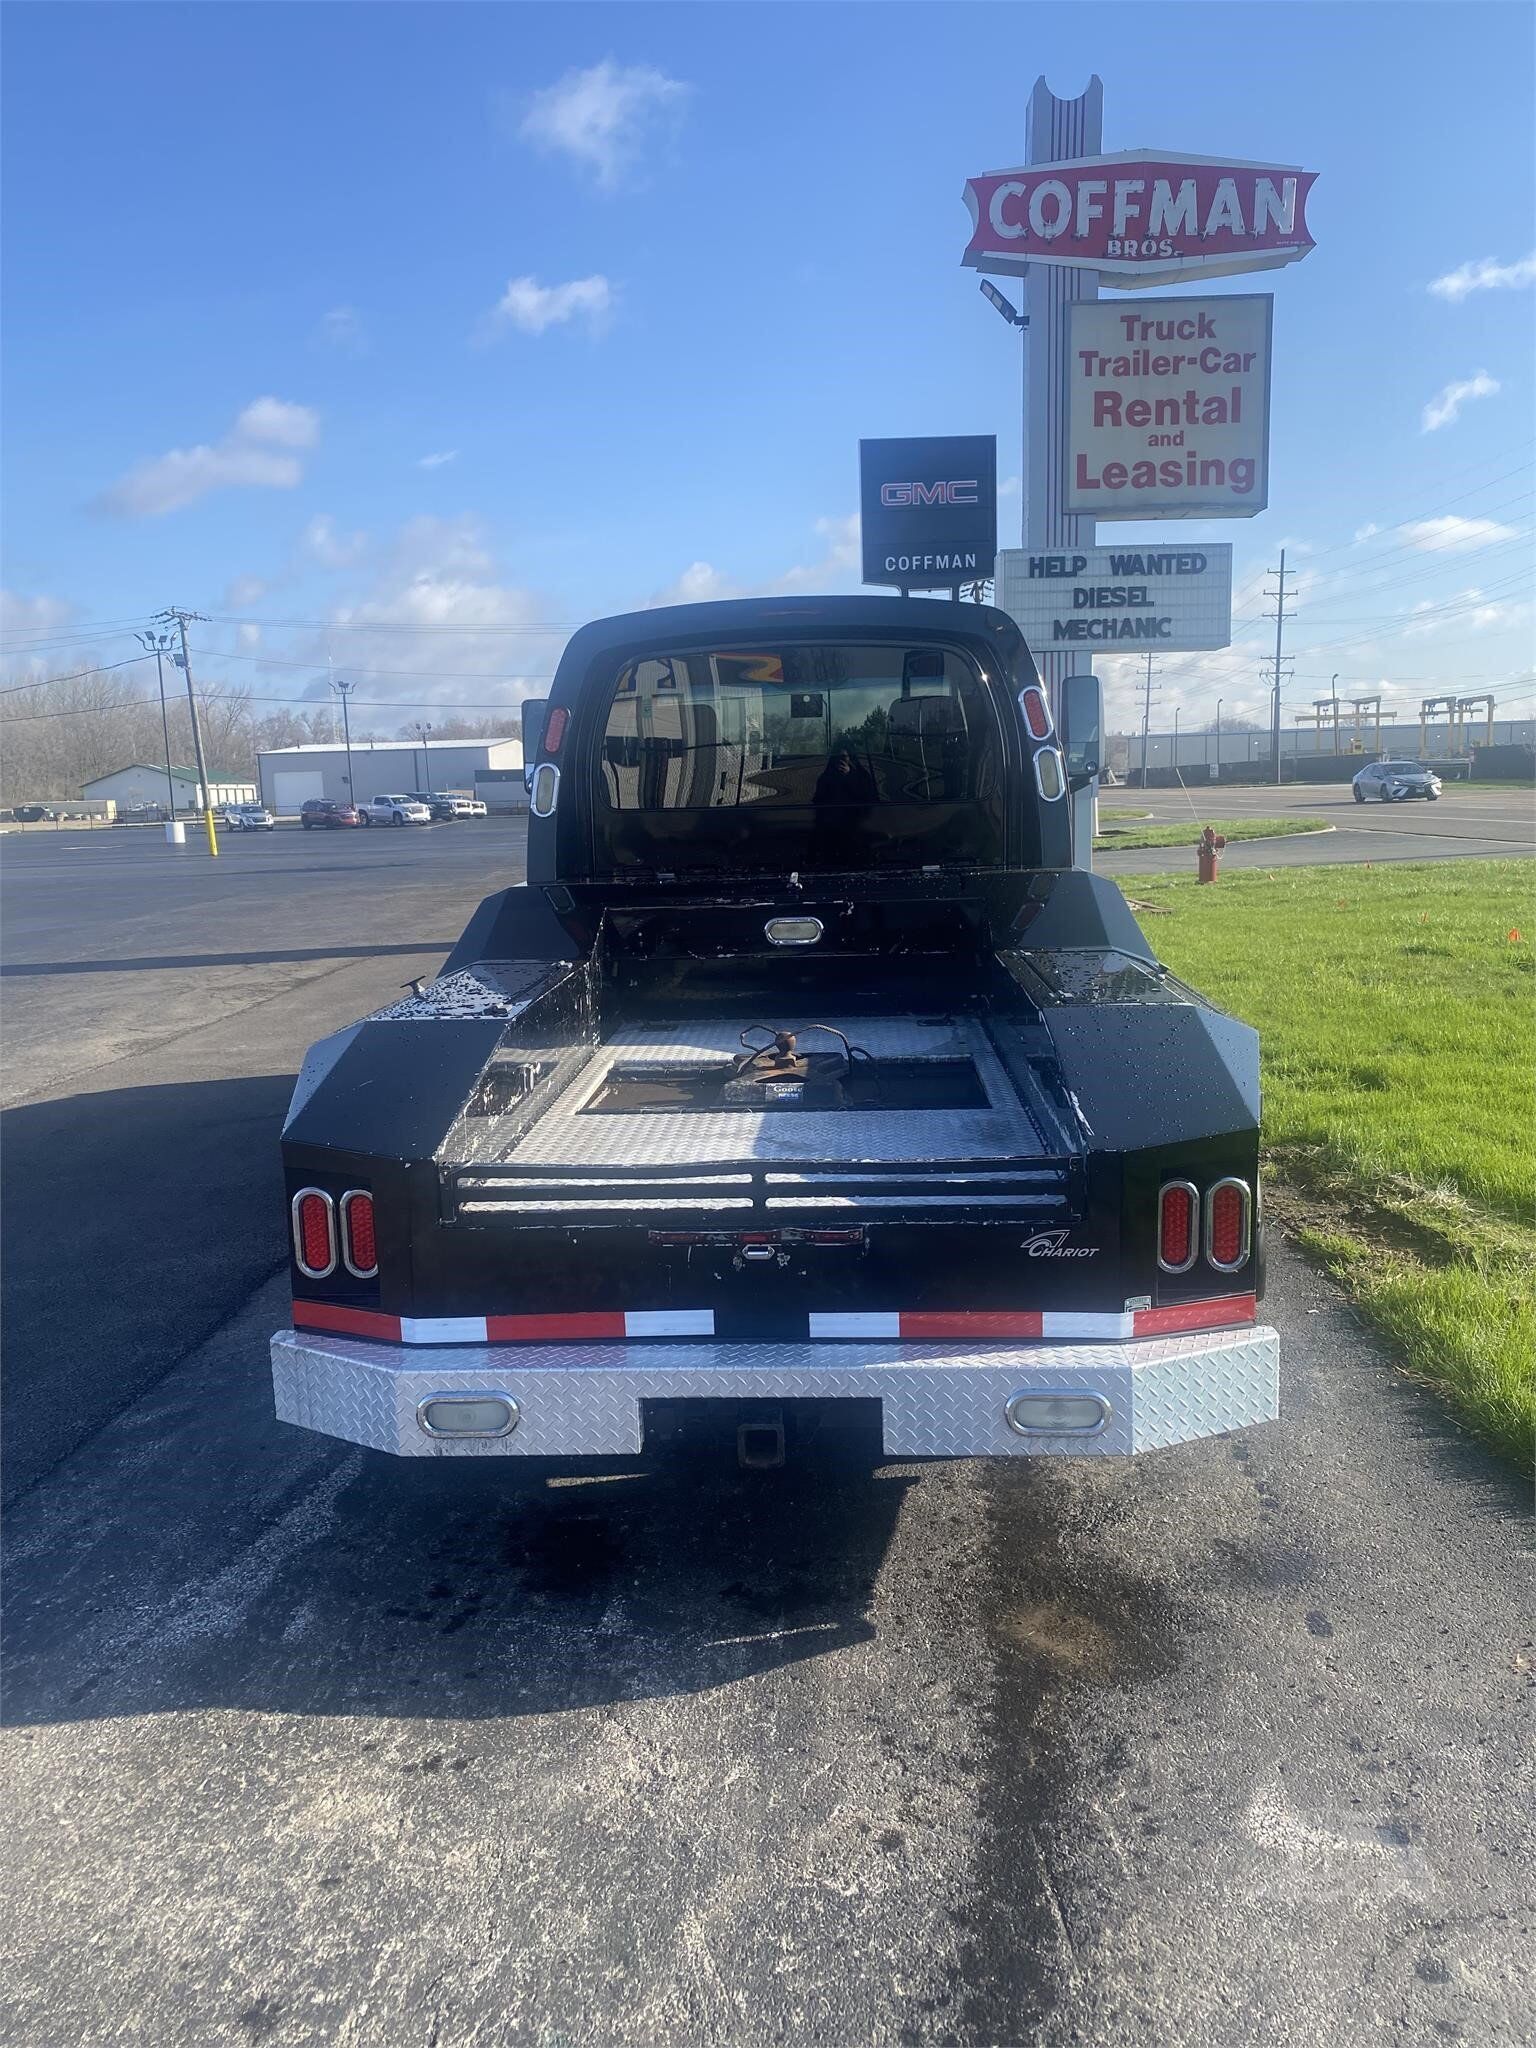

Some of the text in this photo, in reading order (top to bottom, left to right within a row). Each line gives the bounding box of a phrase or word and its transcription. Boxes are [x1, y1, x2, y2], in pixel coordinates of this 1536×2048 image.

[989, 177, 1297, 239] COFFMAN
[1120, 312, 1217, 342] Truck
[1079, 347, 1257, 377] Trailer-Car
[1093, 387, 1242, 428] Rental
[1148, 431, 1185, 447] and
[1076, 451, 1256, 494] Leasing
[881, 480, 978, 506] GMC
[885, 553, 976, 571] COFFMAN
[1029, 553, 1207, 578] HELP WANTED
[1073, 586, 1155, 609] DIESEL
[1053, 616, 1172, 641] MECHANIC
[1028, 1241, 1100, 1257] CHARIOT
